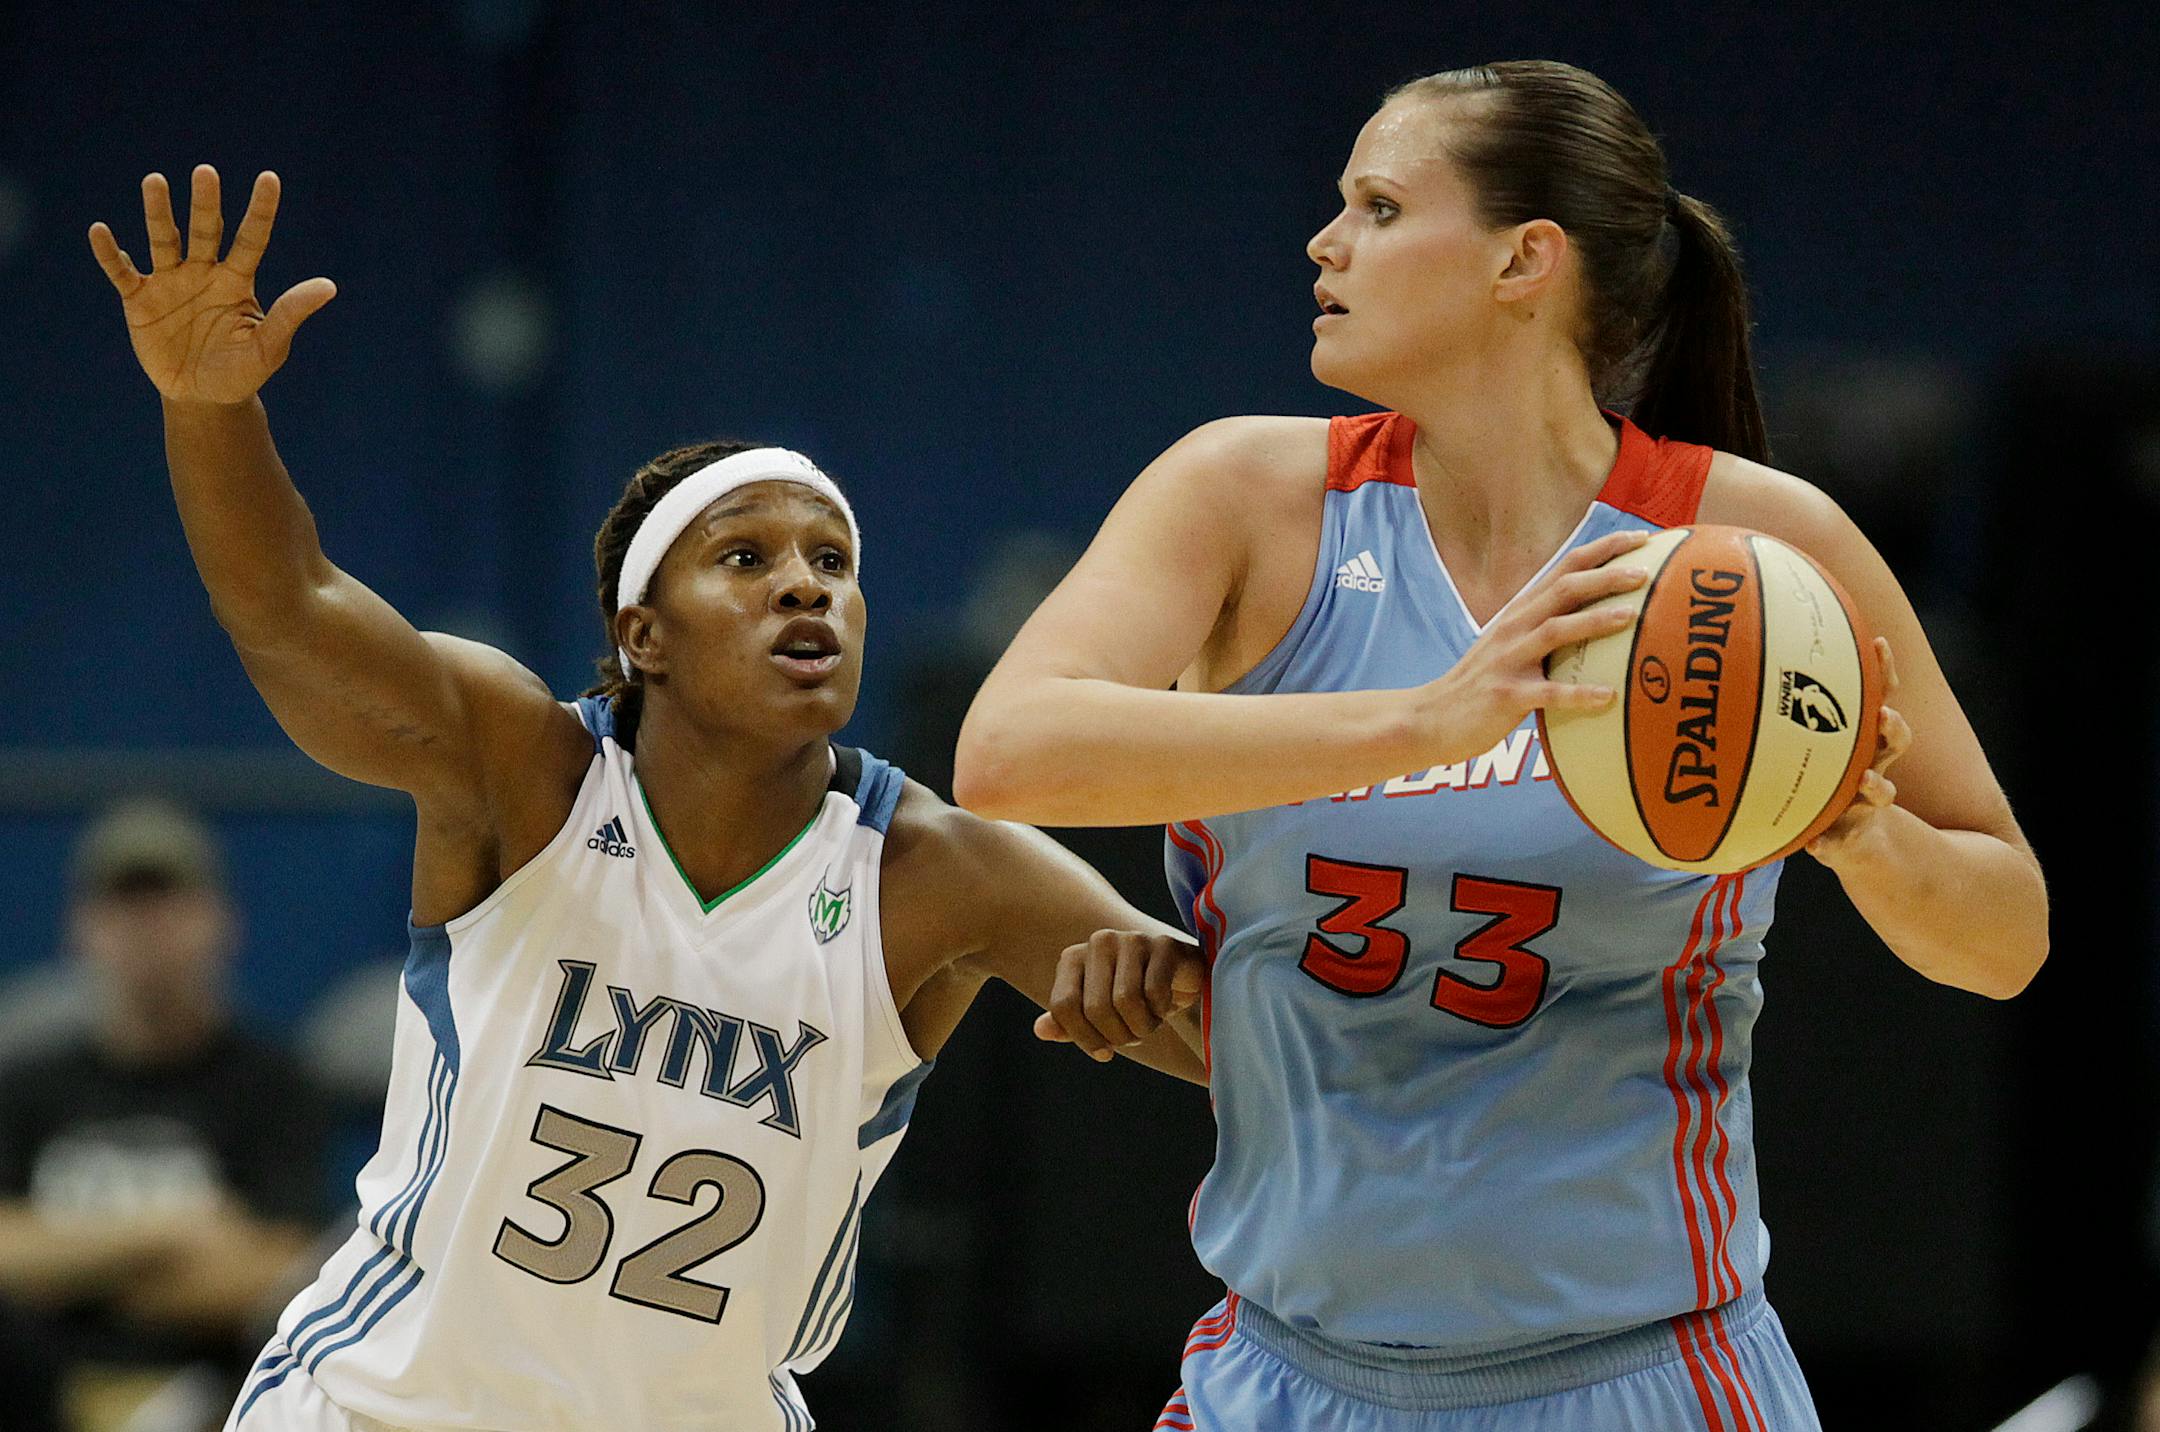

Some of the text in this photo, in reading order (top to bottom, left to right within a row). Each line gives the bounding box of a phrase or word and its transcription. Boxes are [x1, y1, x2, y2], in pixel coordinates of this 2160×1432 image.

[1664, 568, 1746, 808] SPALDING
[1778, 670, 1793, 717] WNBA
[1298, 853, 1563, 1030] 33
[525, 959, 829, 1139] LYNX
[492, 1103, 766, 1325] 32
